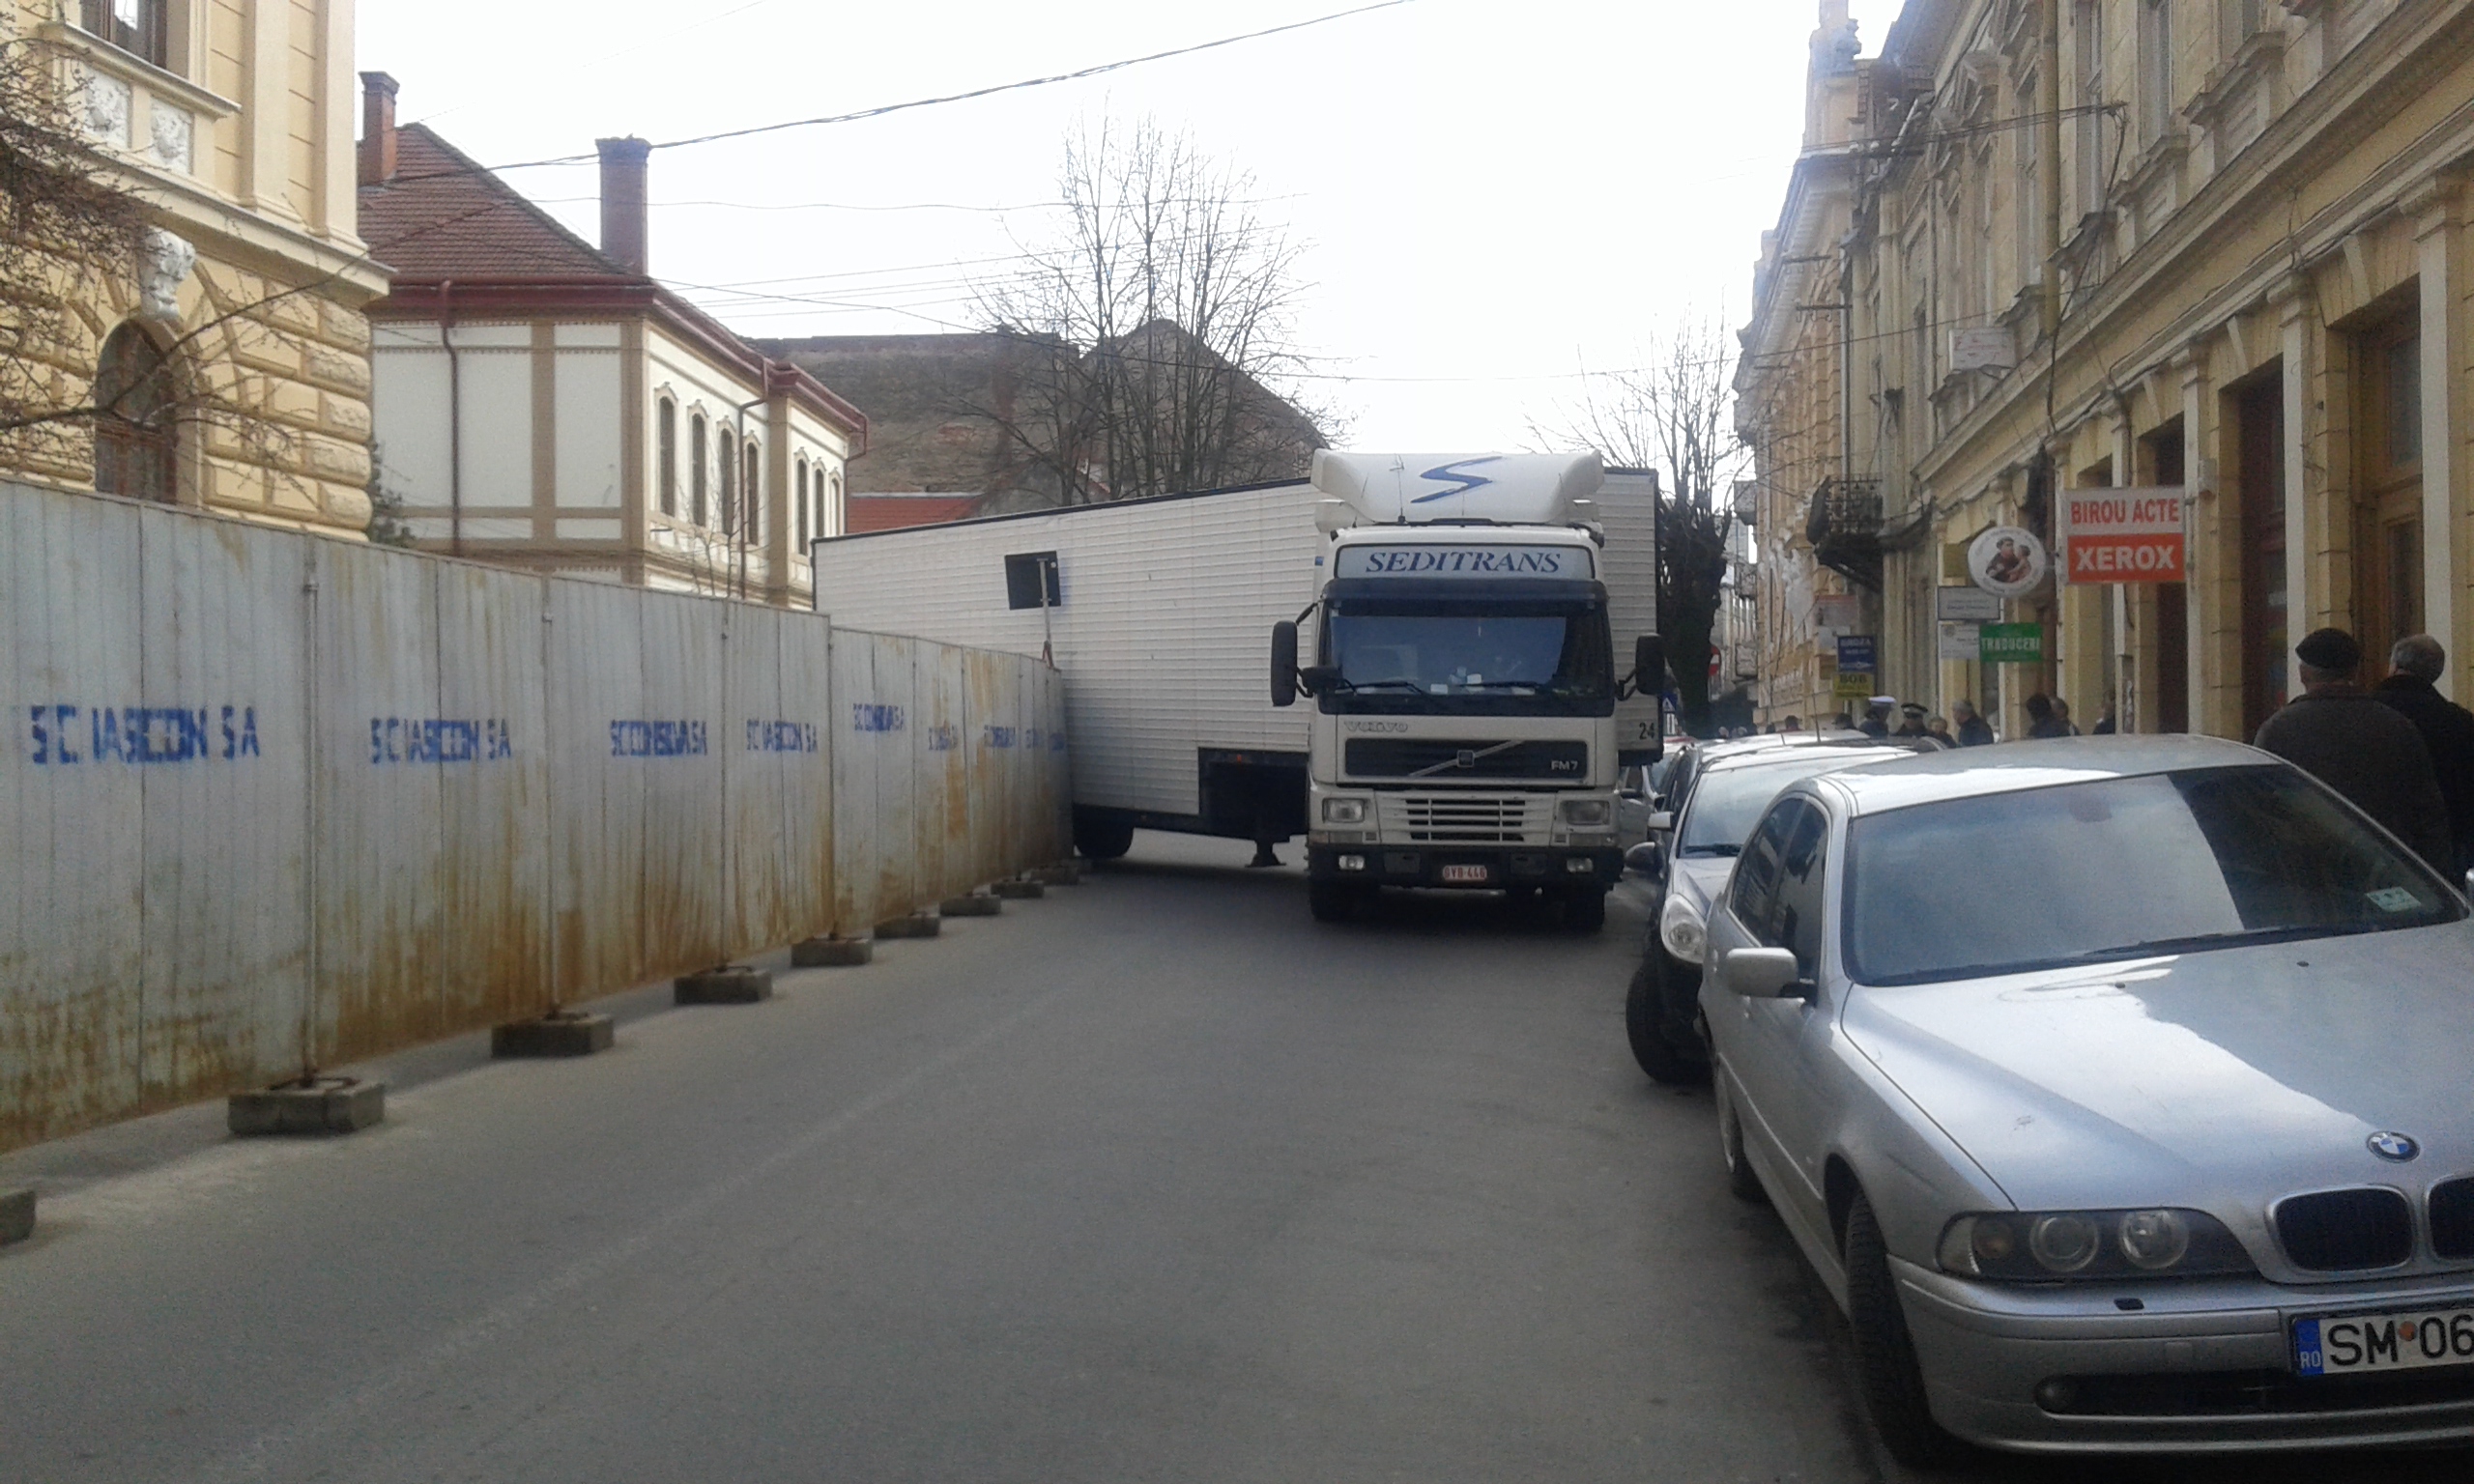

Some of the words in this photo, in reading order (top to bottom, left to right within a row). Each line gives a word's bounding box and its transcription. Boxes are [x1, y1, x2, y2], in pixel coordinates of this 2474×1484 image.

[2070, 499, 2127, 525] BIROU
[2132, 498, 2180, 523] ACTE
[1365, 551, 1562, 574] SEDITRANS
[2075, 543, 2175, 573] XEROX
[1981, 637, 2041, 652] TRADUCERI
[31, 704, 79, 764] SC
[221, 704, 260, 759] SA
[1343, 720, 1409, 733] VOLVO
[1638, 722, 1655, 740] 24
[370, 718, 399, 762] SC
[487, 719, 512, 758] SA
[1550, 759, 1579, 771] FM7
[2327, 1320, 2399, 1367] SM
[2419, 1313, 2474, 1359] 06
[2300, 1351, 2322, 1369] RO
